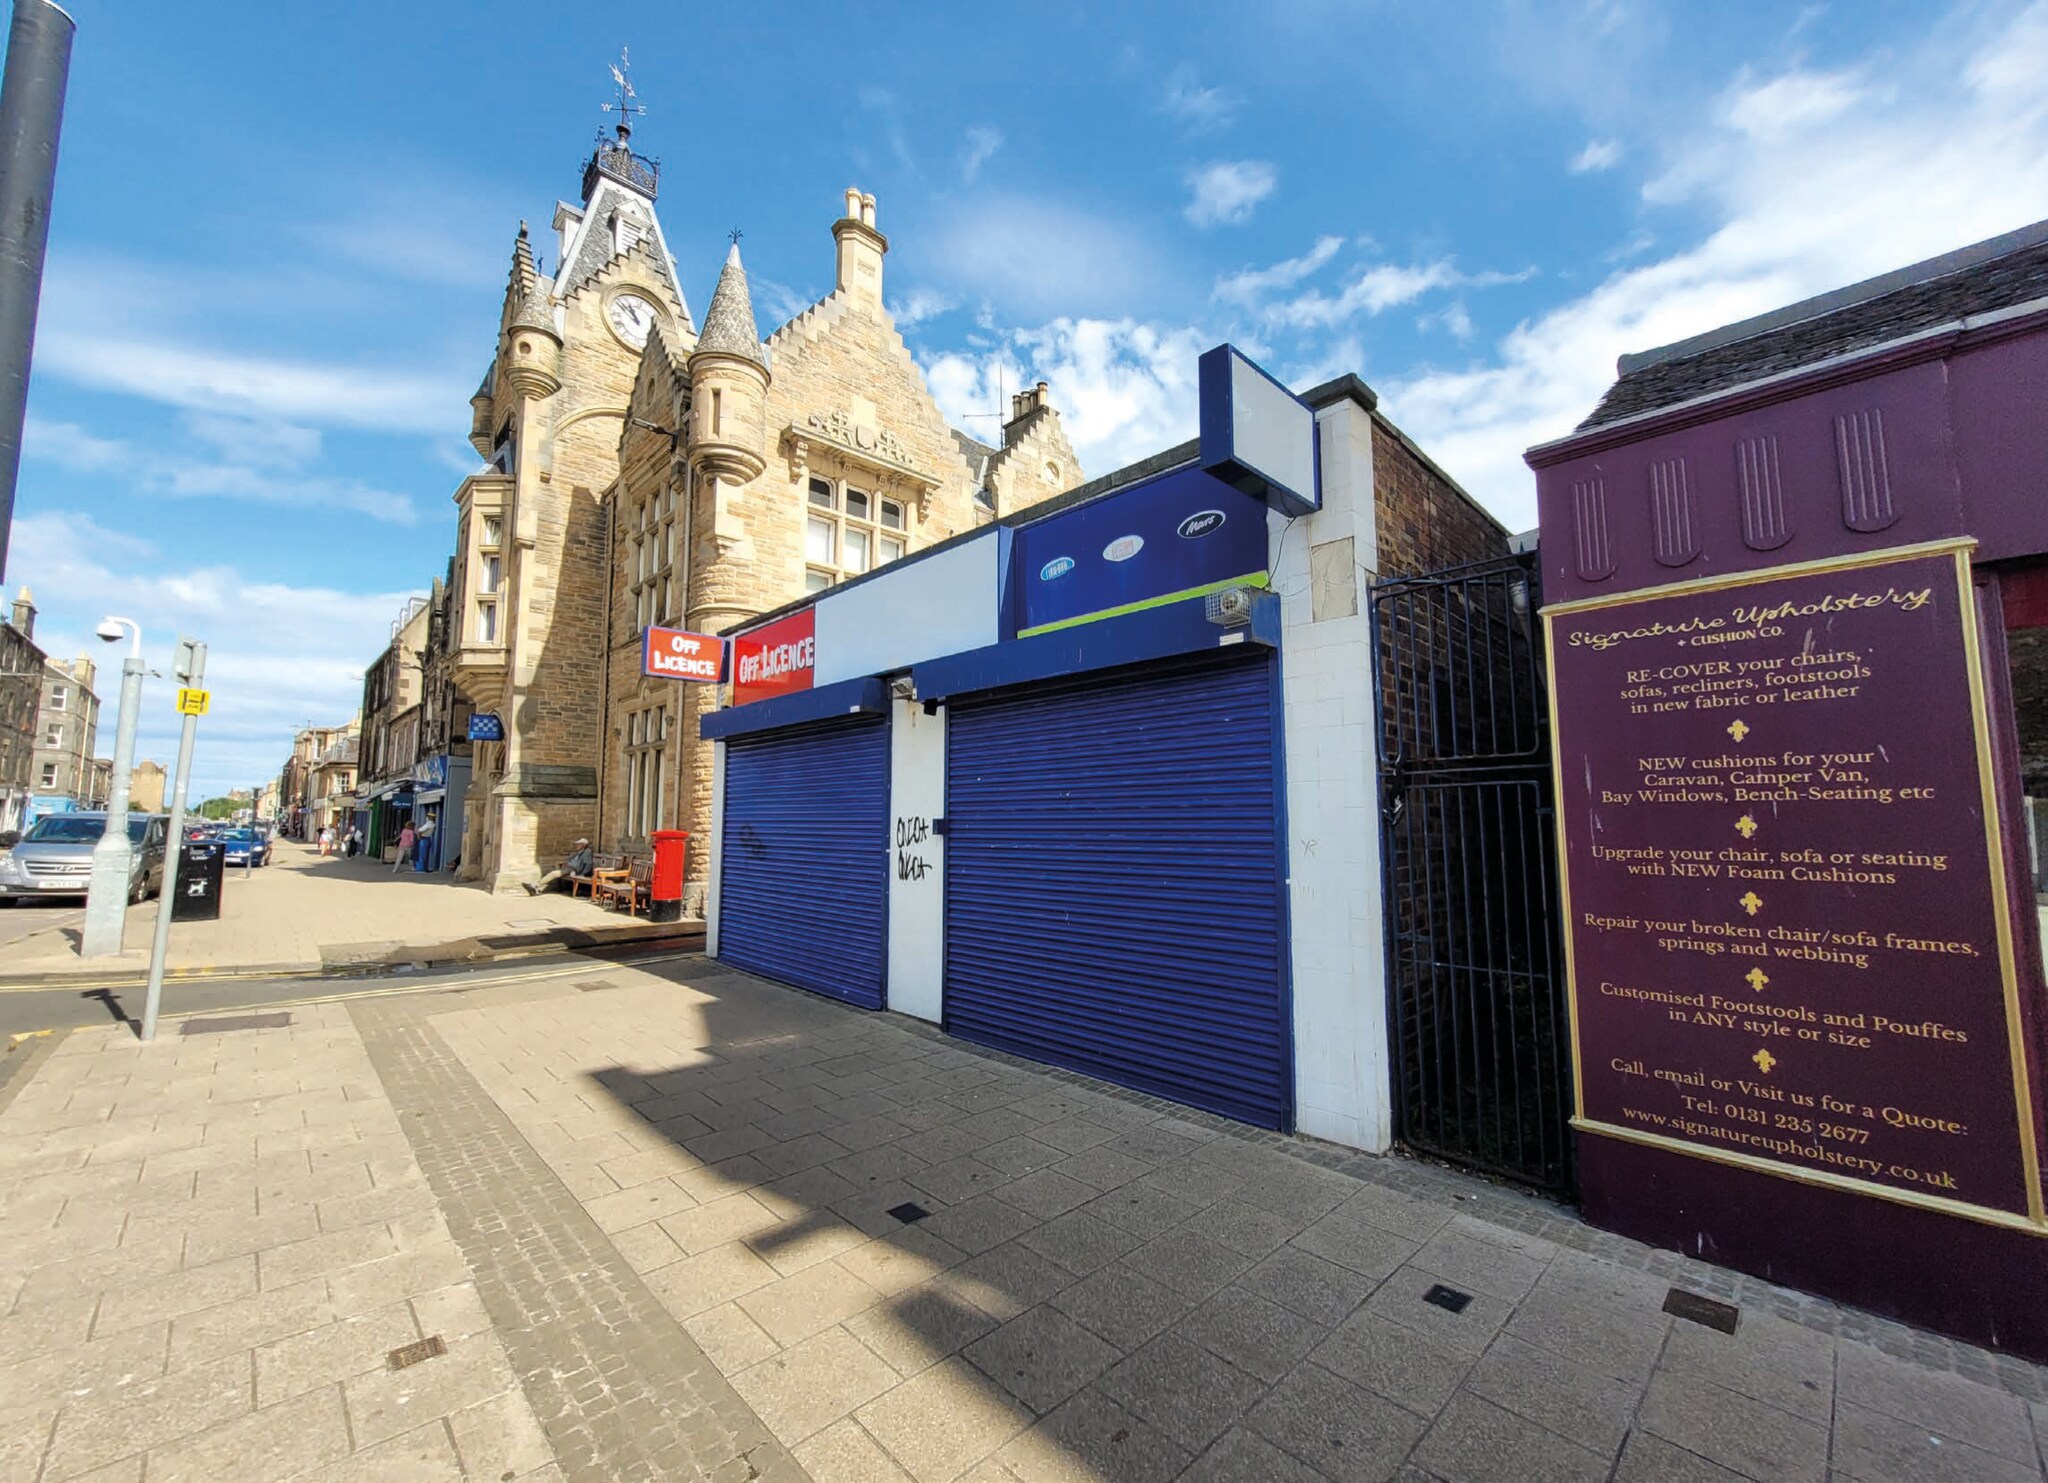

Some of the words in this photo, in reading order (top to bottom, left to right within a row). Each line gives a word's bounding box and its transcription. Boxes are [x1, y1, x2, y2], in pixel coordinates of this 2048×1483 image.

[1568, 618, 1726, 650] Signature
[1733, 587, 1932, 628] Upholstery
[671, 636, 700, 655] OFF
[1692, 630, 1755, 646] CUSHION
[1760, 626, 1785, 638] CO.
[654, 651, 716, 676] LICENCE
[739, 655, 760, 683] OFF
[762, 636, 814, 678] LICENCE
[1627, 661, 1732, 683] RE-COVER
[1738, 656, 1783, 674] your
[1791, 649, 1861, 666] chairs,
[1621, 683, 1666, 699] sofas,
[1672, 675, 1759, 694] recliners,
[1765, 664, 1870, 686] footstools
[1631, 701, 1647, 713] in
[1653, 701, 1689, 712] new
[1696, 691, 1749, 708] fabric
[1756, 692, 1776, 703] or
[1783, 684, 1860, 701] leather
[1639, 757, 1686, 771] NEW
[1692, 754, 1777, 769] cushions
[1783, 752, 1815, 766] for
[1821, 752, 1875, 769] your
[1644, 773, 1724, 788] Caravan,
[1730, 770, 1813, 787] Camper
[1818, 768, 1870, 784] Van,
[1601, 791, 1632, 806] Bay
[1638, 789, 1729, 805] Windows,
[1735, 786, 1892, 803] Bench-Seating
[1900, 786, 1935, 800] etc
[1592, 846, 1664, 861] Upgrade
[1669, 848, 1714, 862] your
[1719, 848, 1774, 864] chair,
[1780, 848, 1824, 864] sofa
[1830, 852, 1854, 865] or
[1862, 851, 1948, 870] seating
[1627, 863, 1665, 875] with
[1672, 864, 1721, 877] NEW
[1728, 865, 1785, 880] Foam
[1791, 867, 1896, 884] Cushions
[1584, 913, 1639, 933] Repair
[1644, 920, 1688, 934] your
[1693, 921, 1761, 938] broken
[1768, 926, 1878, 948] chair/sofa
[1887, 934, 1980, 957] frames,
[1658, 935, 1725, 954] springs
[1731, 942, 1768, 956] and
[1774, 945, 1869, 968] webbing
[1601, 982, 1704, 1007] Customised
[1711, 996, 1817, 1023] Footstools
[1824, 1013, 1866, 1030] and
[1874, 1017, 1968, 1043] Pouffes
[1669, 1008, 1687, 1022] in
[1693, 1012, 1736, 1029] ANY
[1743, 1018, 1791, 1037] style
[1797, 1028, 1821, 1041] or
[1828, 1029, 1871, 1048] size
[1611, 1058, 1649, 1078] Call,
[1654, 1066, 1705, 1086] email
[1711, 1077, 1733, 1091] or
[1738, 1080, 1784, 1101] Visit
[1791, 1092, 1814, 1106] us
[1822, 1096, 1855, 1115] for
[1862, 1107, 1874, 1118] a
[1881, 1107, 1969, 1136] Quote:
[1681, 1095, 1718, 1114] Tel:
[1724, 1103, 1767, 1125] 0131
[1775, 1113, 1813, 1134] 235
[1819, 1122, 1870, 1145] 2677
[1623, 1106, 1959, 1190] www.signatureupholstery.co.uk
